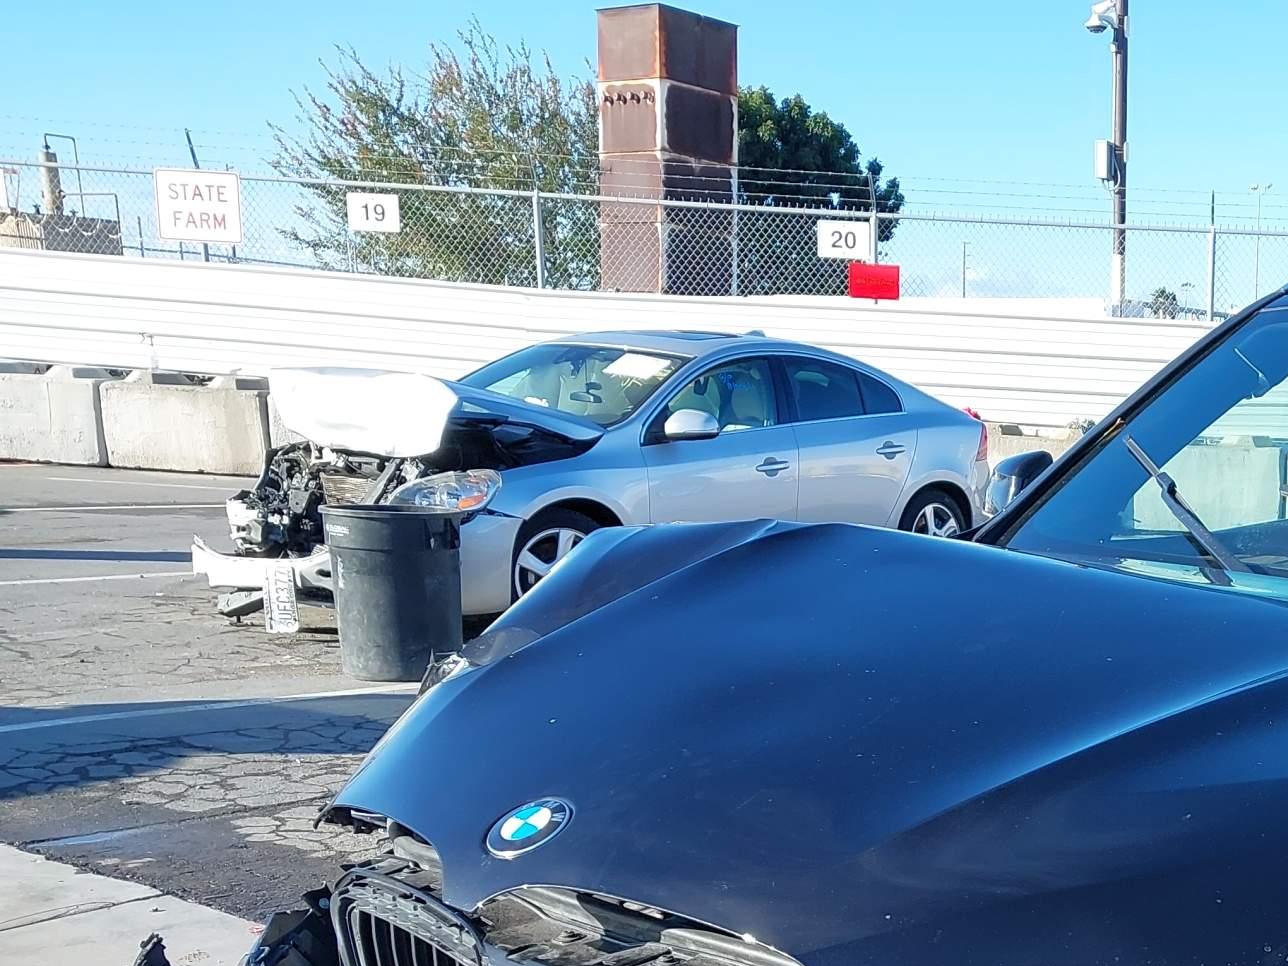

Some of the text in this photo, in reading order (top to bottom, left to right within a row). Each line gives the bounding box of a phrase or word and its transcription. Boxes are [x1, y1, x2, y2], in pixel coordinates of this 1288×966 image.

[168, 183, 228, 203] STATE
[173, 211, 227, 230] FARM
[361, 203, 386, 222] 19
[831, 230, 857, 249] 20
